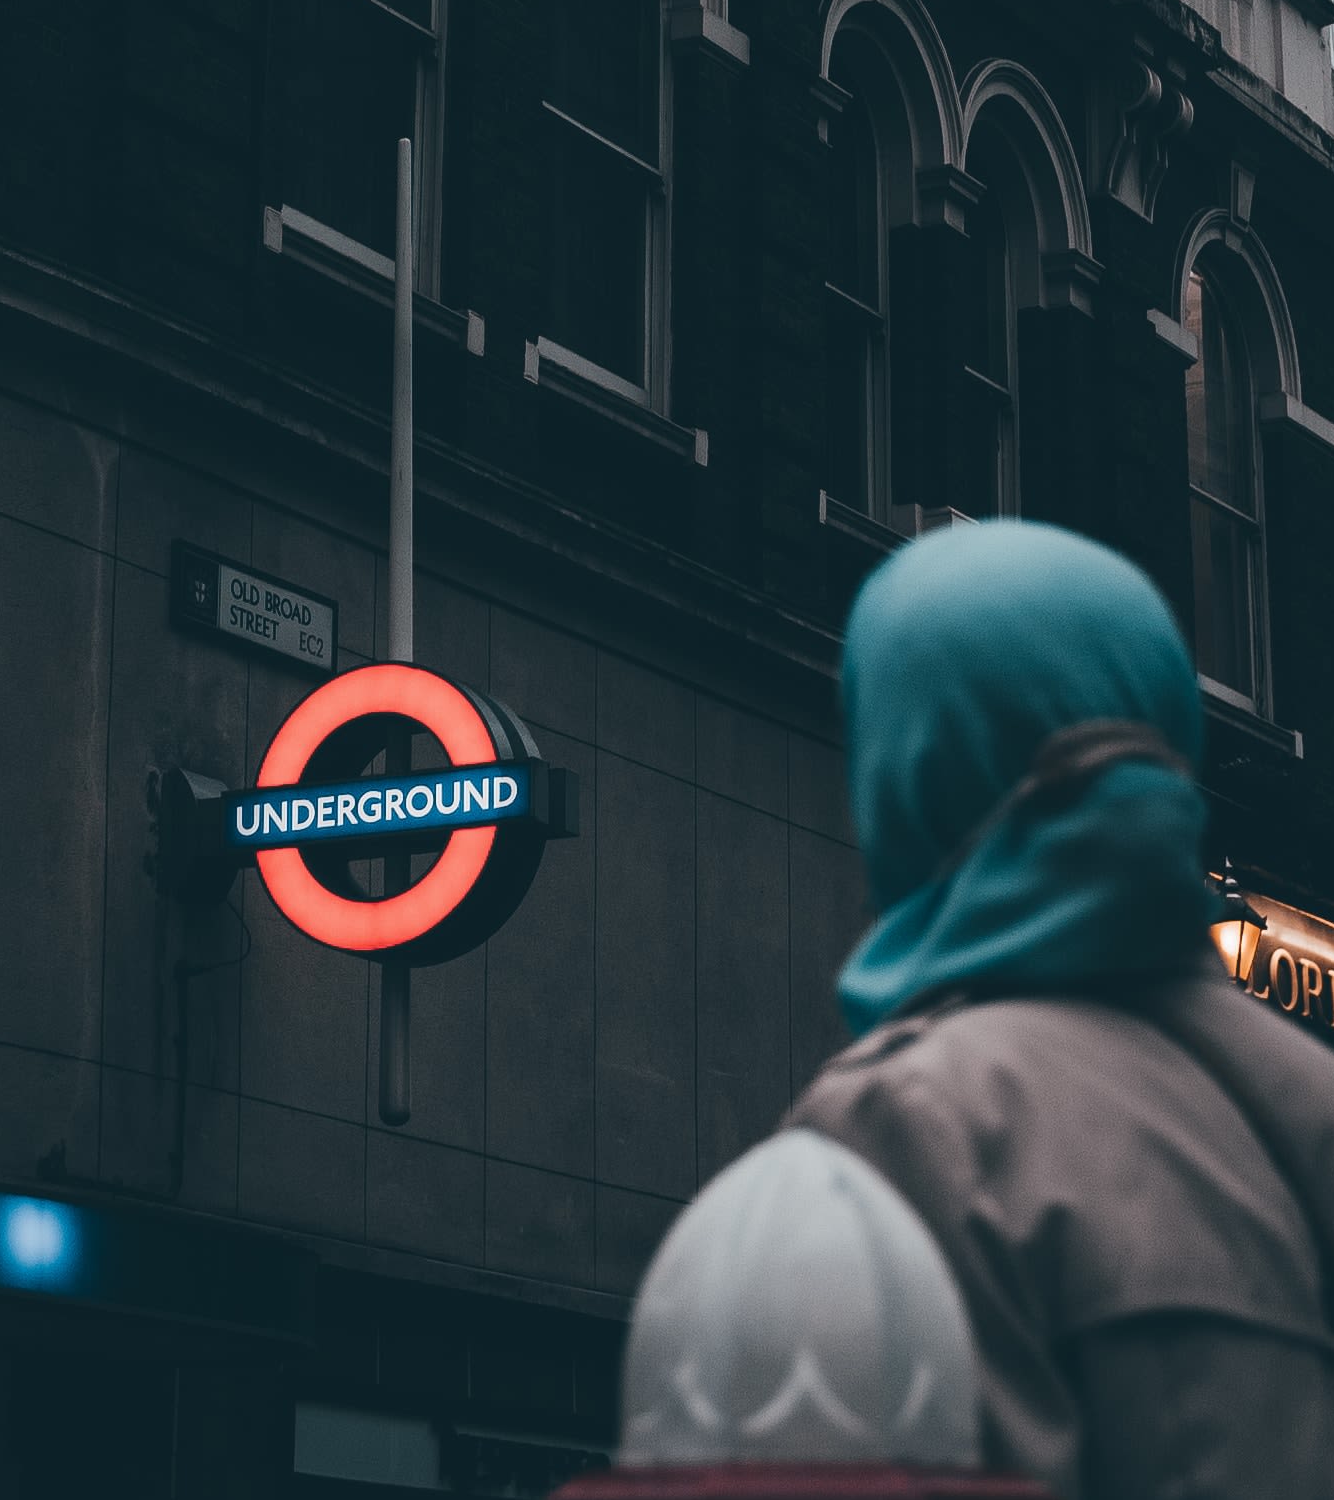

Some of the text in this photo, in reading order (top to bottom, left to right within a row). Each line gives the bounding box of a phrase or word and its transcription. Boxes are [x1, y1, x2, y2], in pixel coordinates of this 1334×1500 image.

[229, 604, 280, 641] STREET
[231, 578, 312, 626] OLD BROAD
[299, 631, 324, 659] EC2
[235, 775, 519, 837] UNDERGROUND
